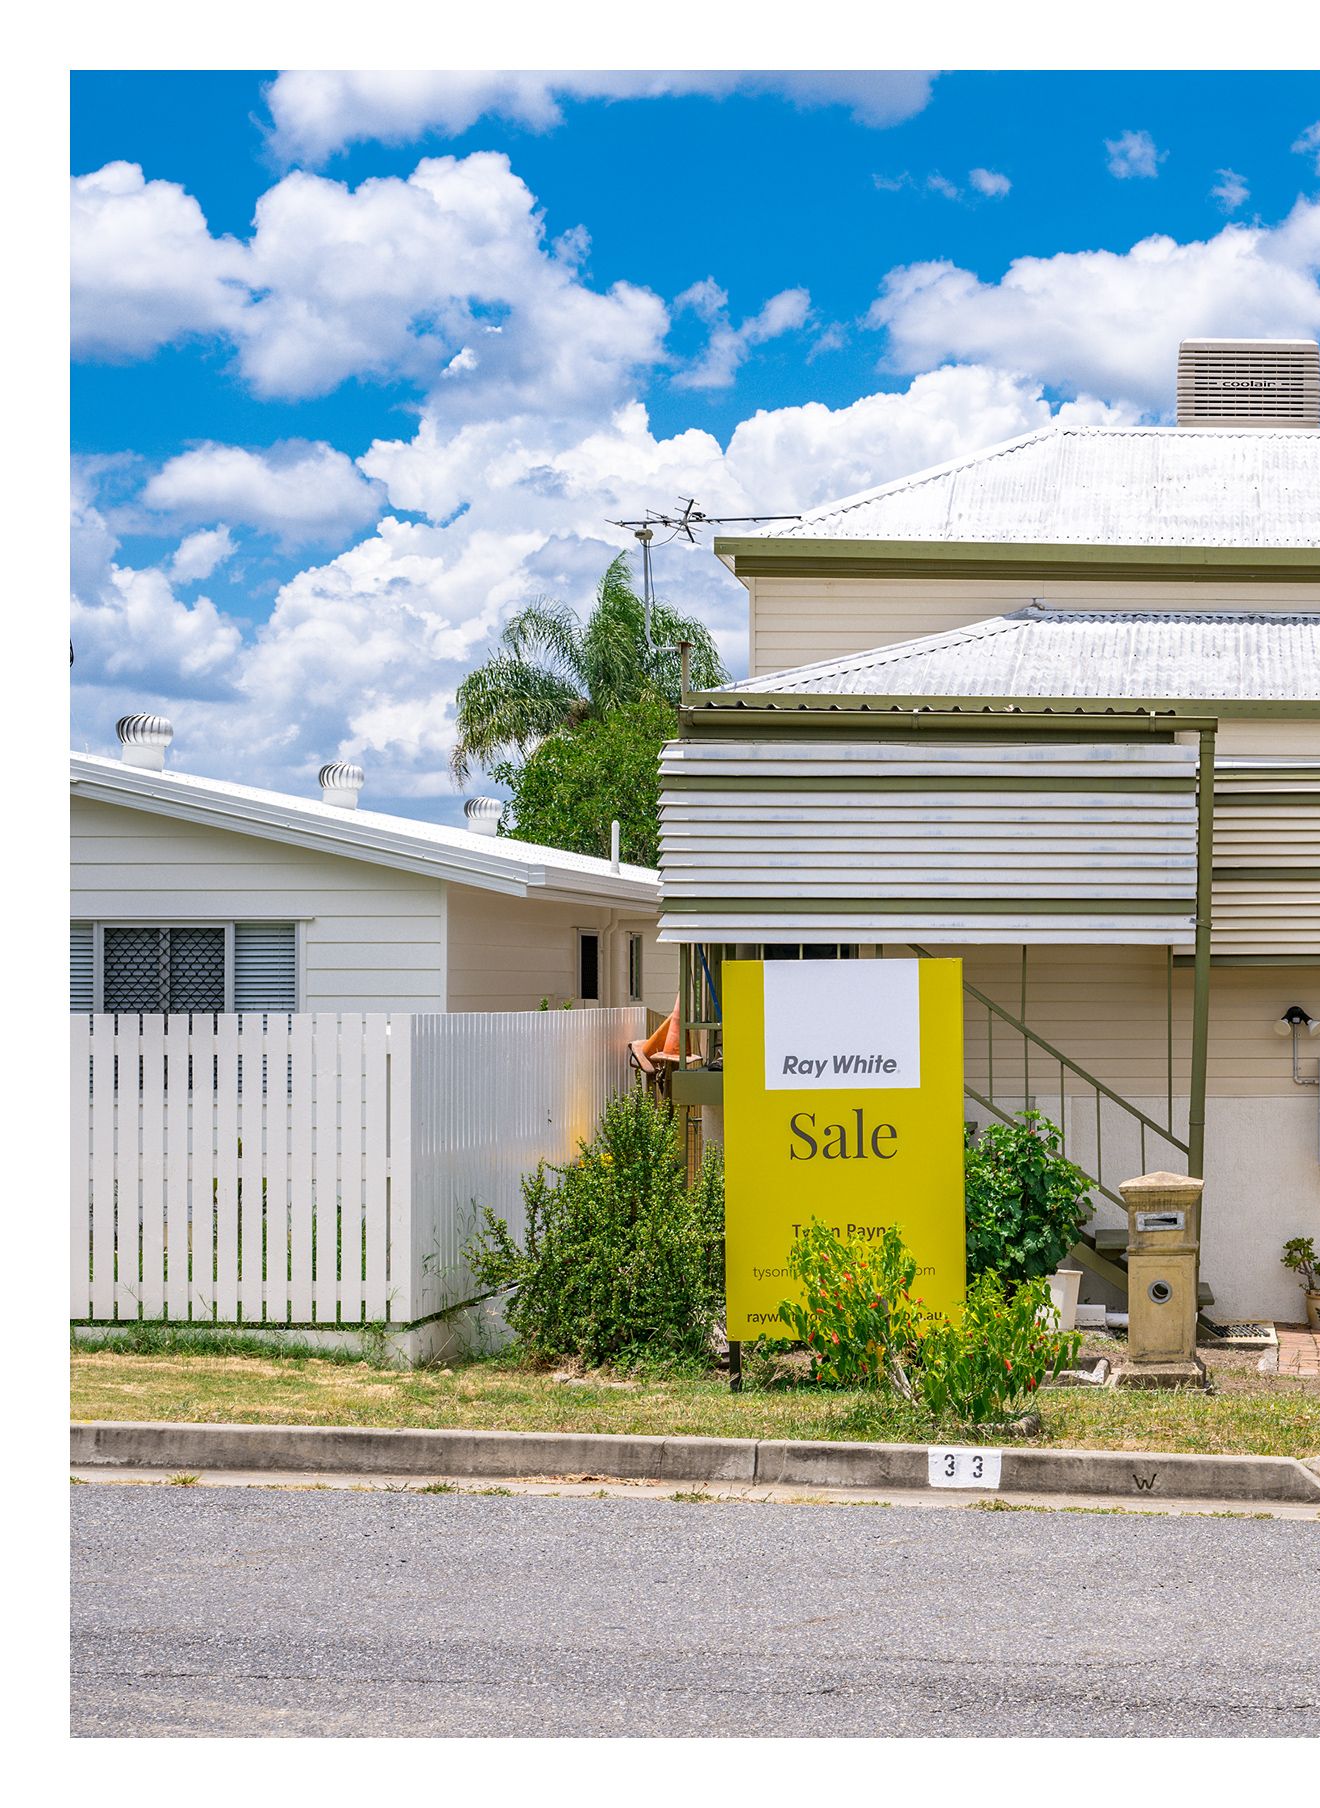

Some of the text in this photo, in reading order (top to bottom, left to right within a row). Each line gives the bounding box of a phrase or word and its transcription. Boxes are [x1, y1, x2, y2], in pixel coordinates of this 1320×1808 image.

[782, 1054, 897, 1078] Ray White
[789, 1108, 898, 1161] Sale
